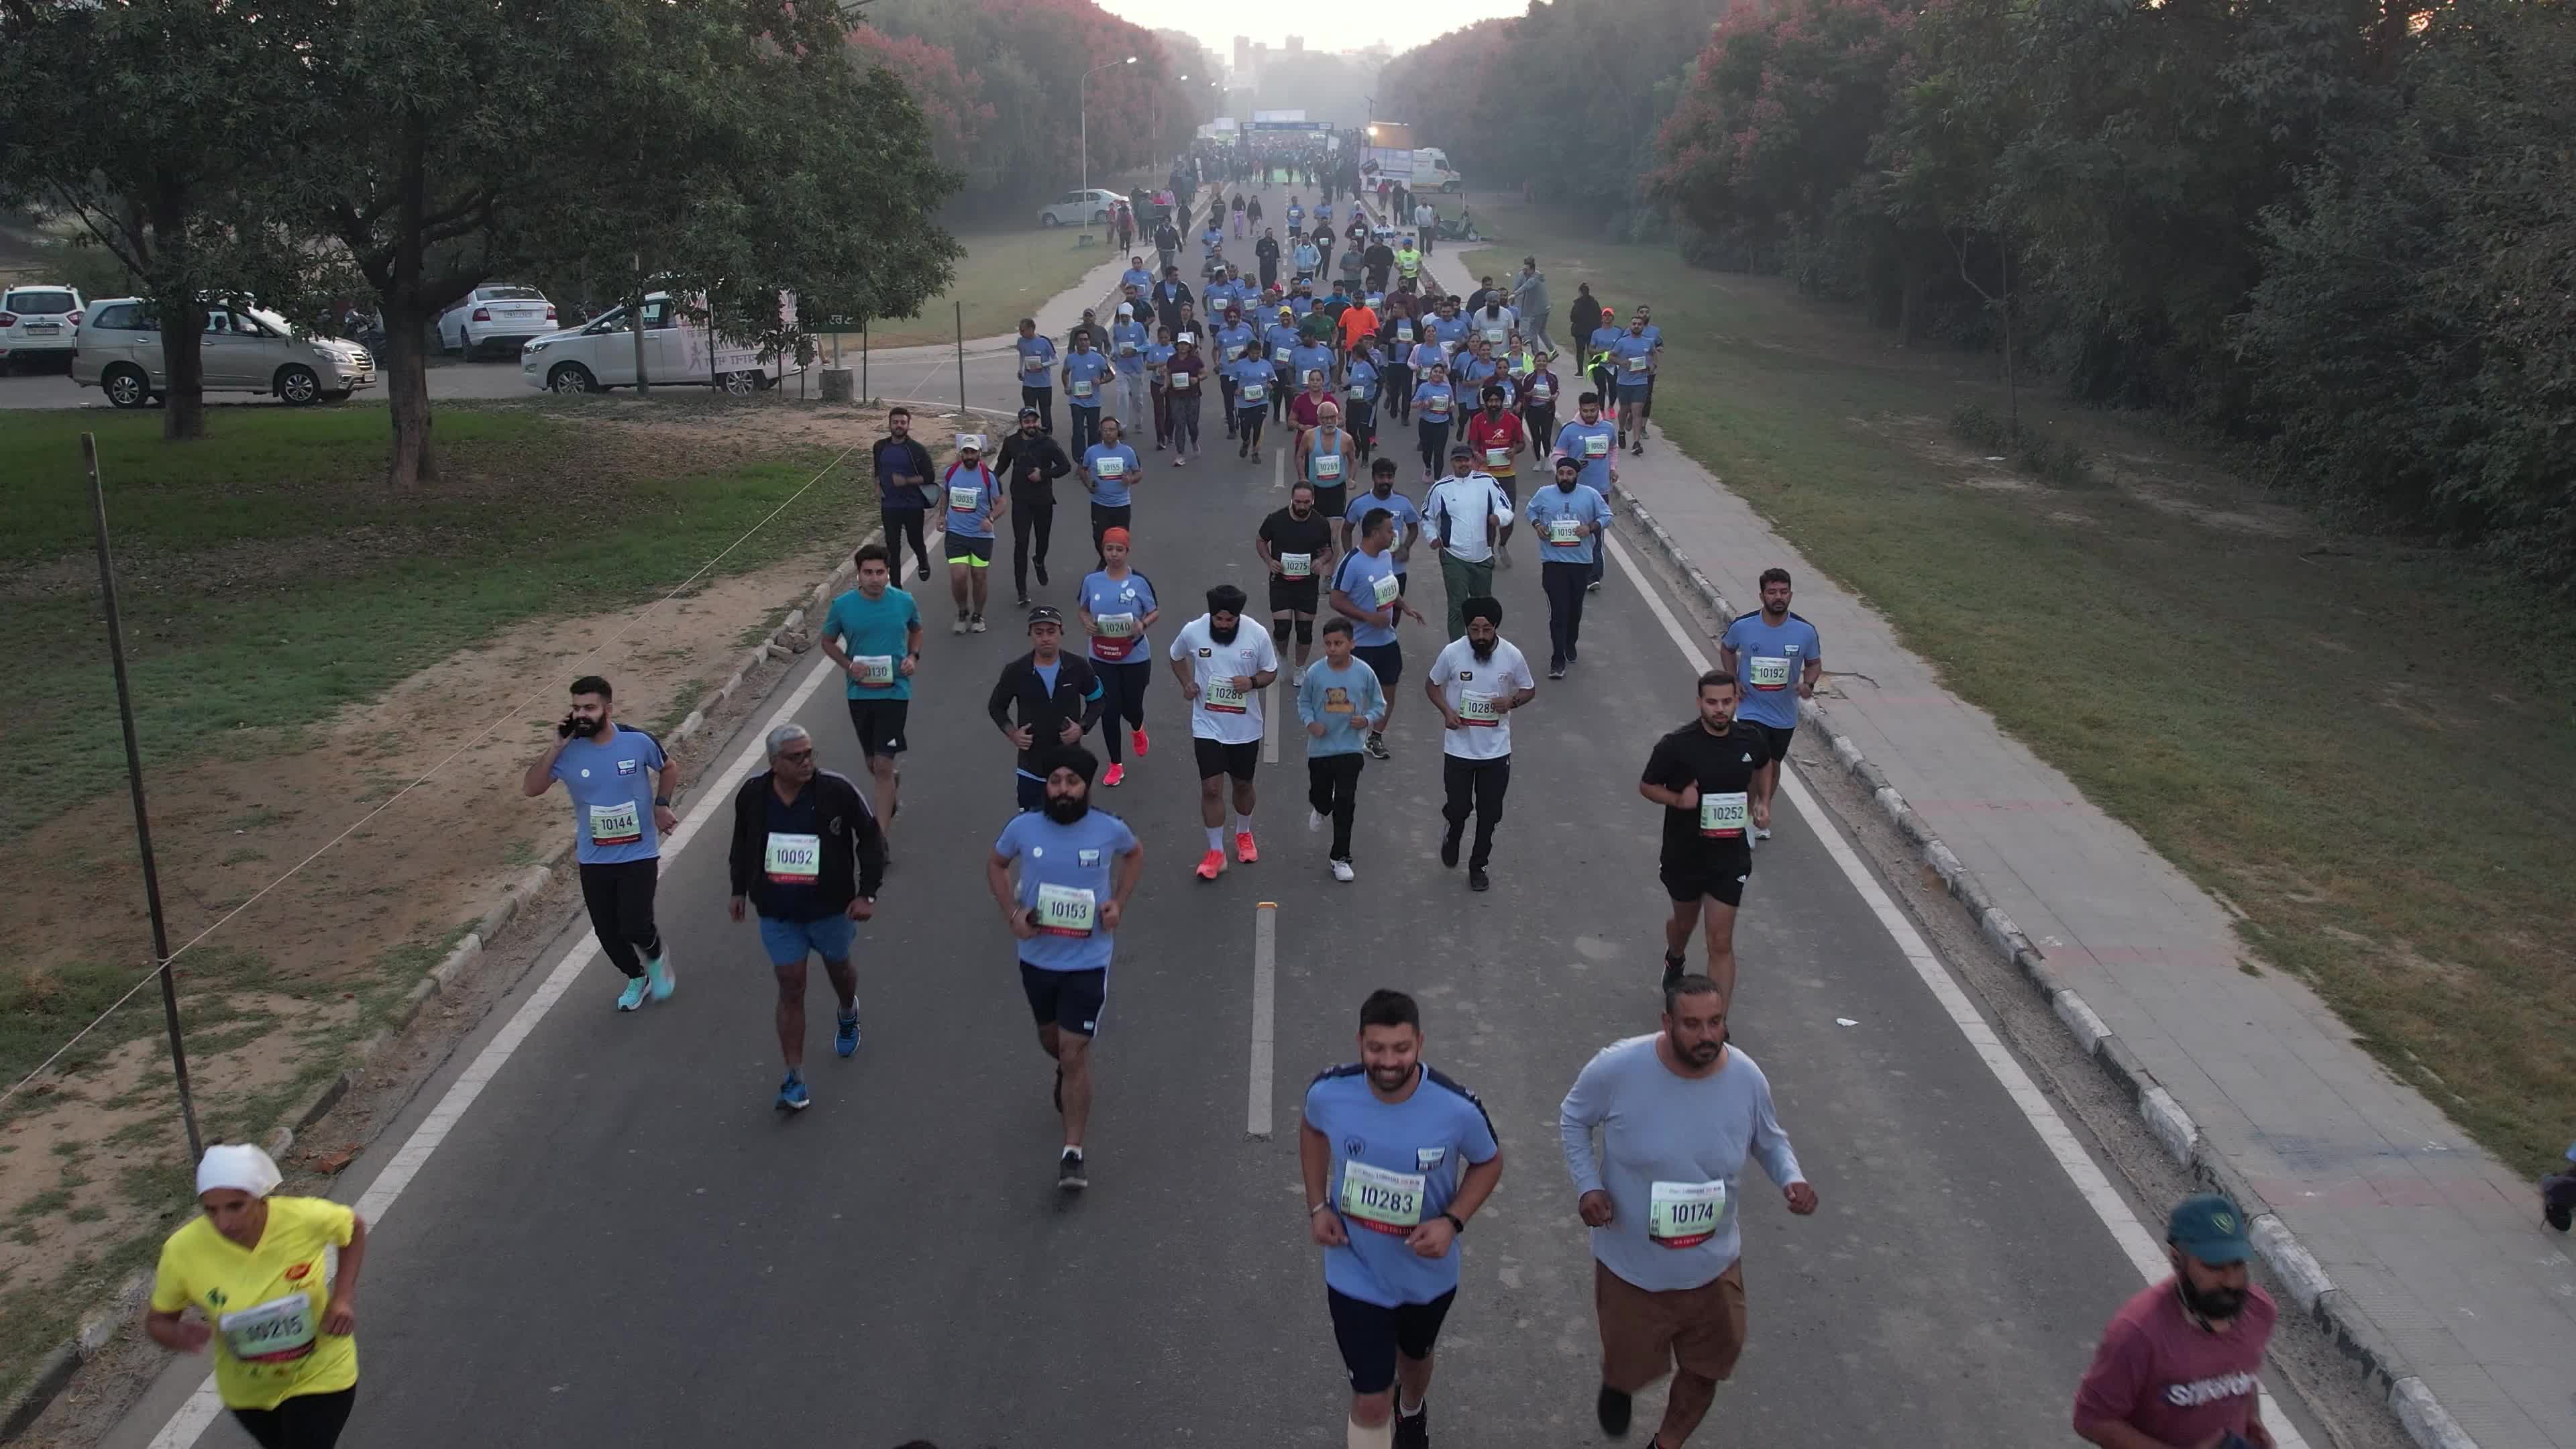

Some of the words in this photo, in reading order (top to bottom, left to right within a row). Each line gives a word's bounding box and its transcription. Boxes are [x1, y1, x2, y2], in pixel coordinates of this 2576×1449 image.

[955, 495, 973, 503] 10035
[1287, 562, 1307, 570] 10275
[1107, 623, 1130, 633] 10240
[1760, 668, 1784, 678] 10192
[1713, 806, 1743, 820] 10252
[601, 816, 633, 830] 10144
[777, 849, 812, 865] 10092
[1051, 902, 1087, 920] 10153
[1361, 1185, 1413, 1214] 10283
[1672, 1203, 1713, 1224] 10174
